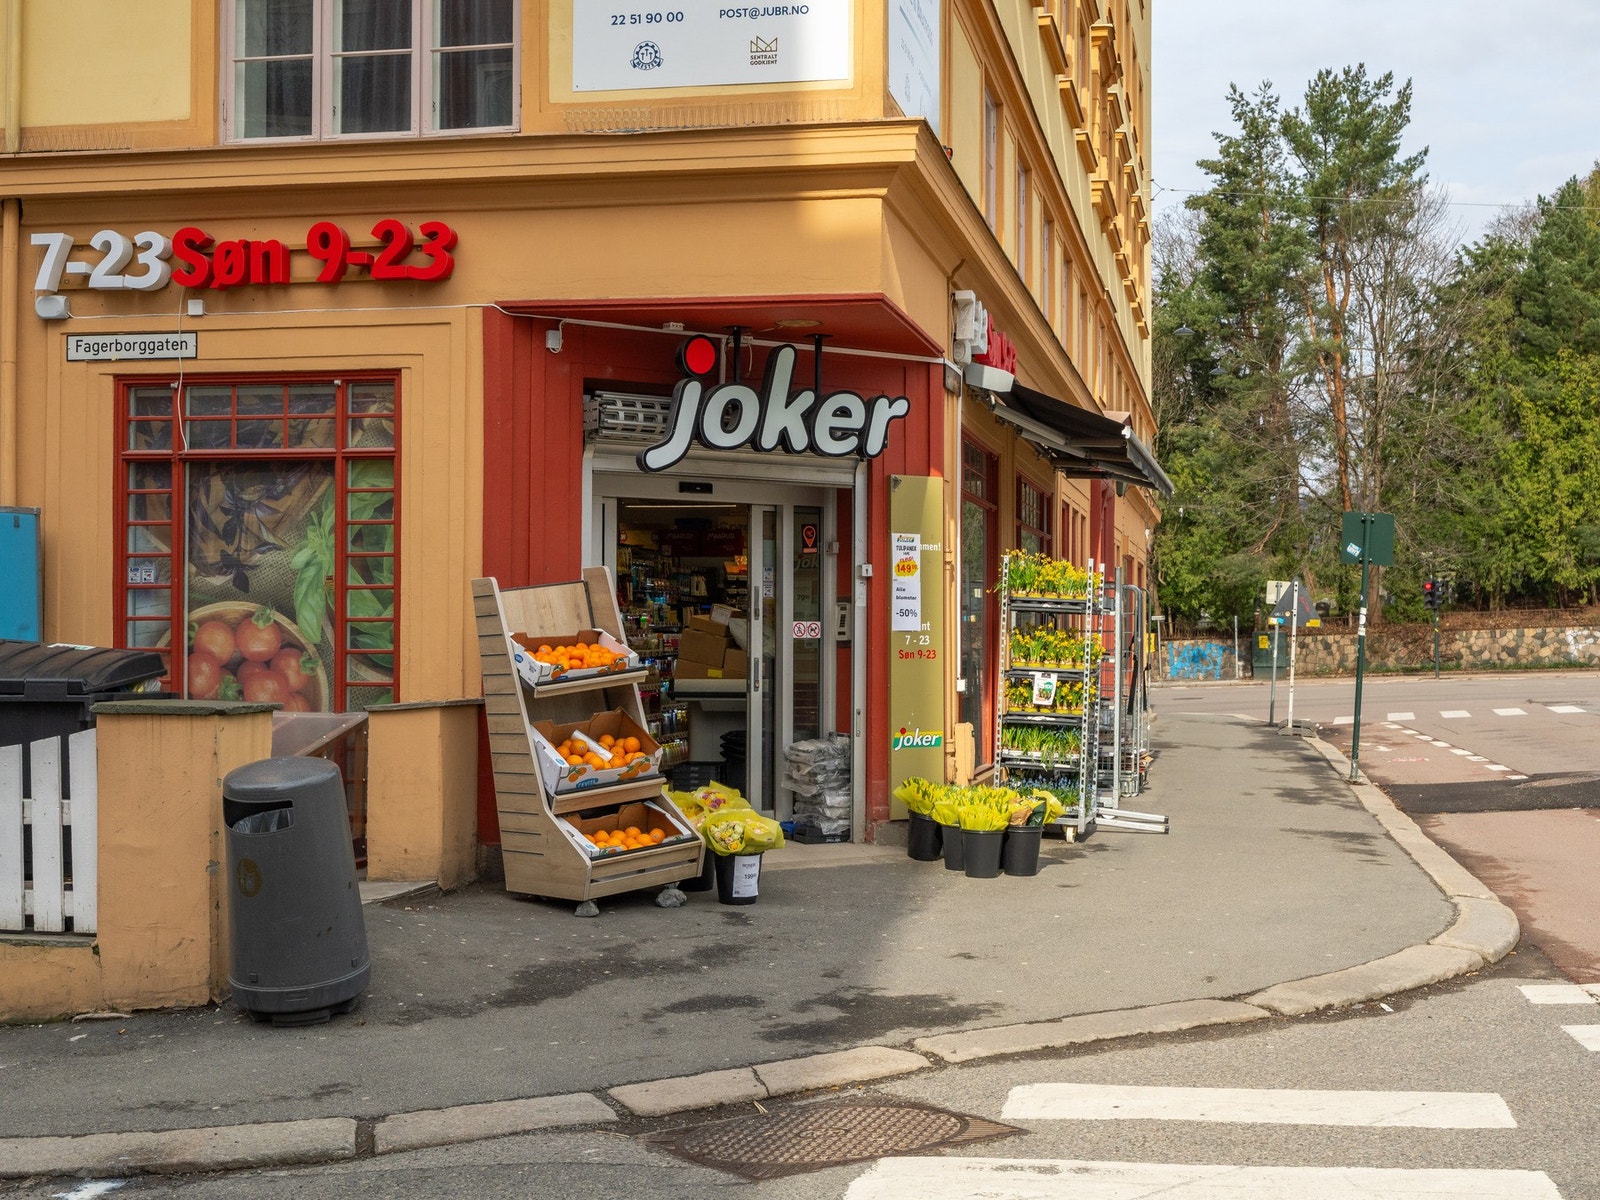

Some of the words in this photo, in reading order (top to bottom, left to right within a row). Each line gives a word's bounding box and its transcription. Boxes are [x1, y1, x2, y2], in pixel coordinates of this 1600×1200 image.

[611, 15, 626, 25] 22
[630, 14, 642, 24] 51
[646, 13, 663, 23] 90
[667, 11, 684, 22] 00
[719, 5, 809, 19] POST@JUBR.NO
[635, 60, 658, 69] MESTER
[31, 229, 173, 292] 7-23
[171, 226, 290, 291] Søn
[306, 218, 458, 284] 9-23
[75, 337, 189, 354] Fagerborggaten
[636, 334, 910, 473] joker
[896, 608, 918, 618] -50%
[905, 635, 911, 645] 7
[919, 635, 930, 645] 23
[898, 649, 915, 659] Søn
[917, 649, 937, 659] 9-23
[894, 727, 940, 751] joker
